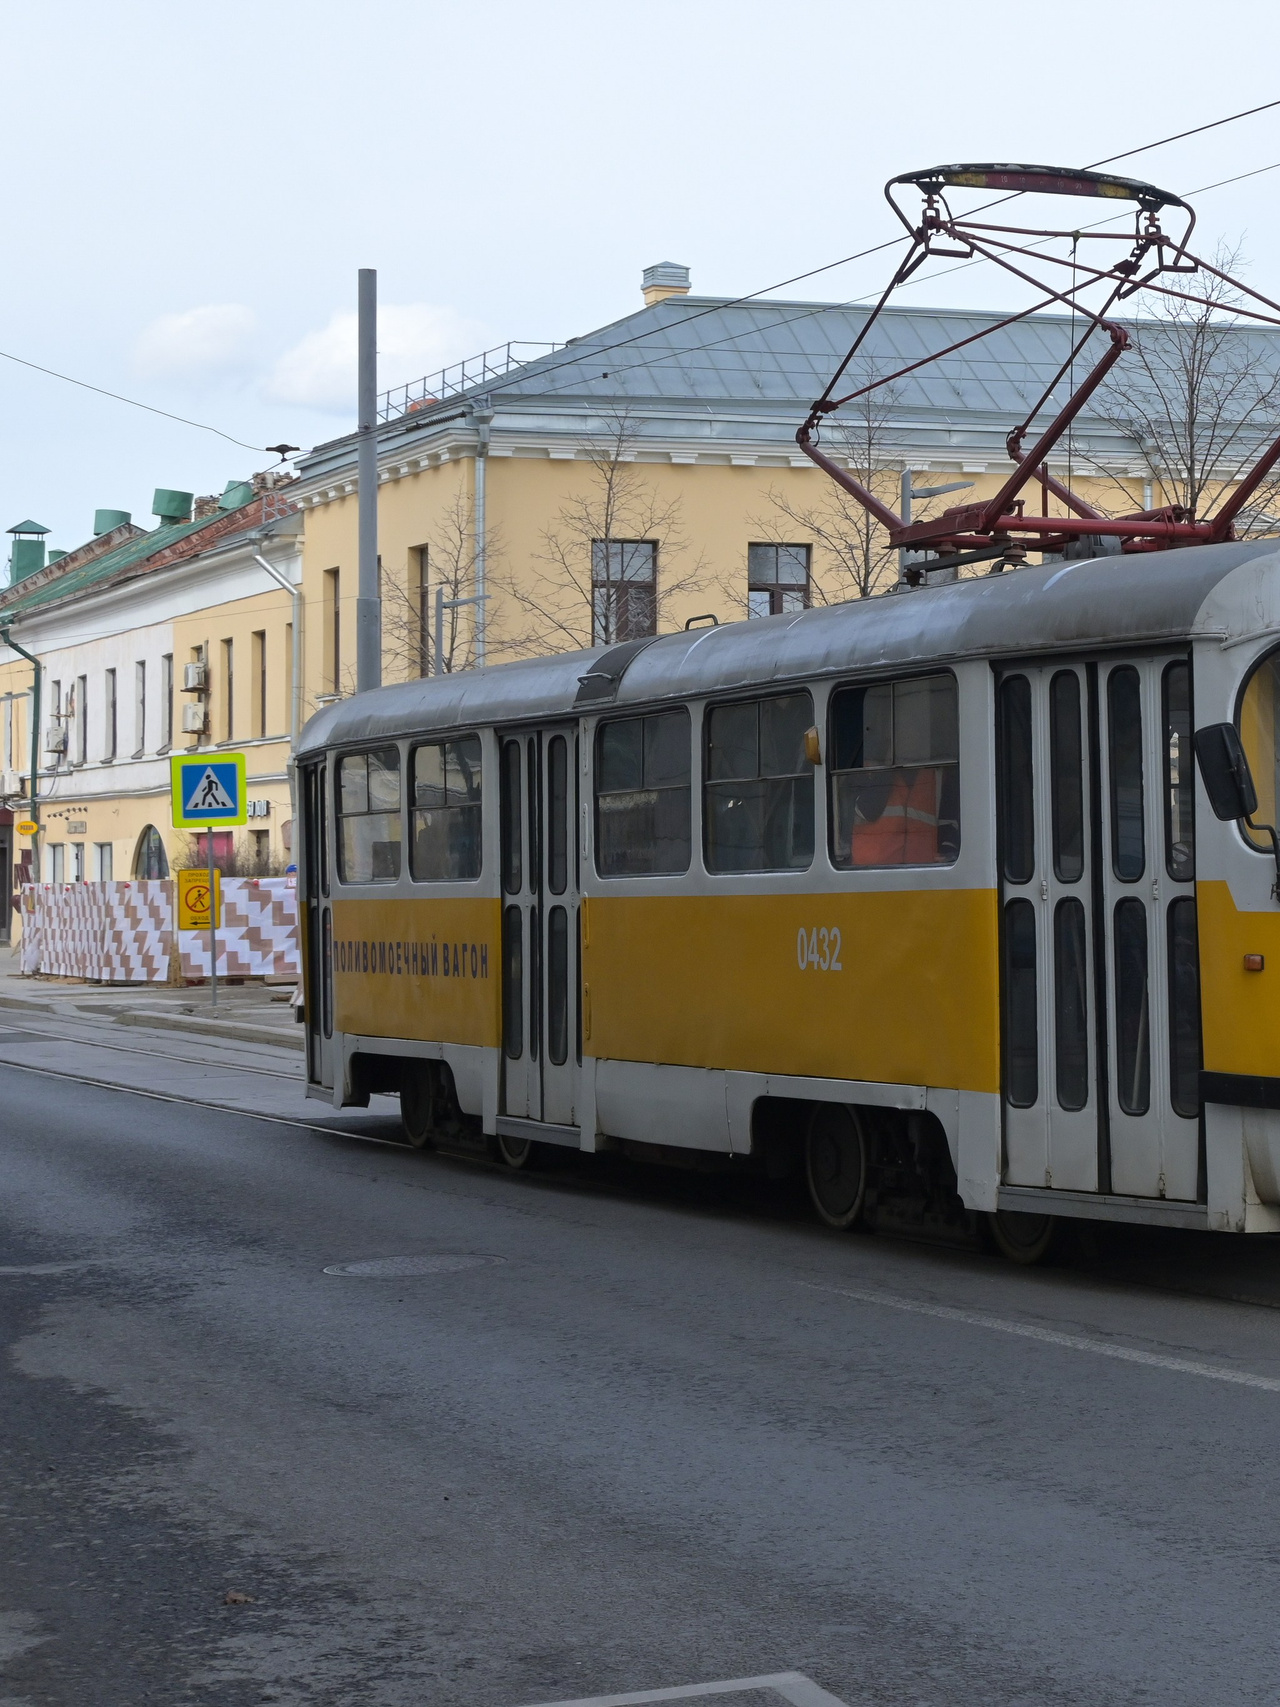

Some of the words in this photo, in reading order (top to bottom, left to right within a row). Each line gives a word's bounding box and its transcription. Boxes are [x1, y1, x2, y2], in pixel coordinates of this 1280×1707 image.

[333, 933, 438, 976] ПОЛИВОМОЕЧНЫЙ
[443, 942, 488, 979] ВАГОН
[797, 926, 842, 971] 0432
